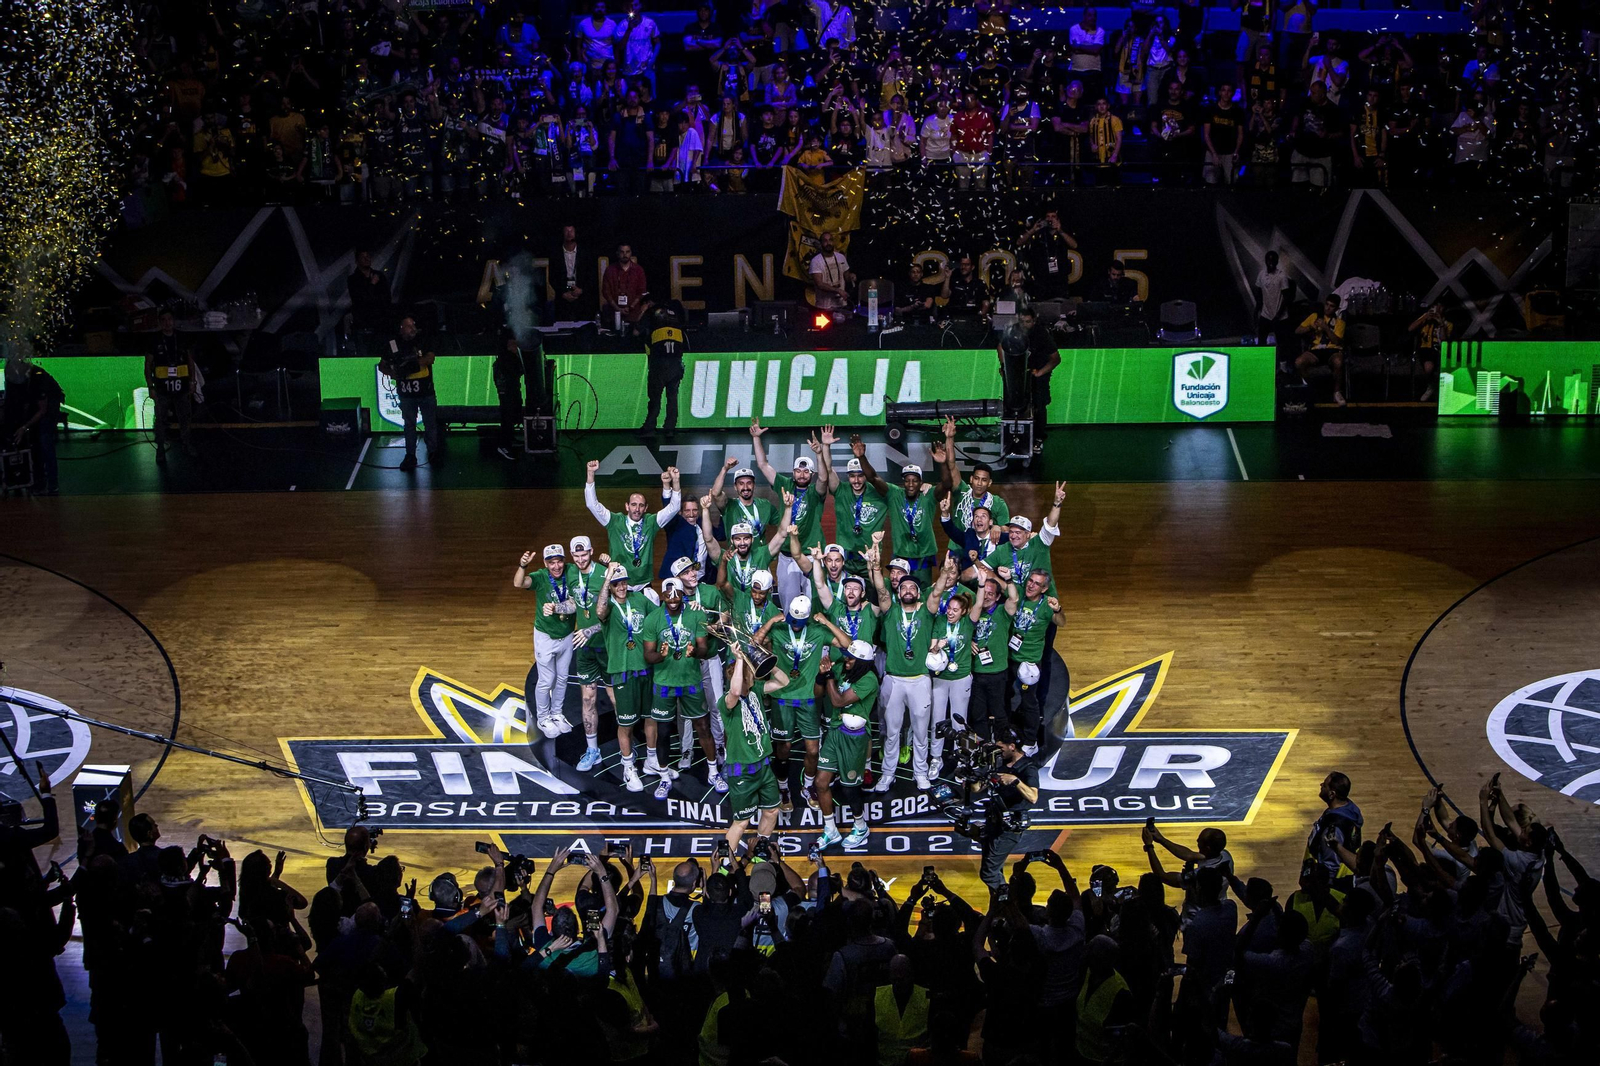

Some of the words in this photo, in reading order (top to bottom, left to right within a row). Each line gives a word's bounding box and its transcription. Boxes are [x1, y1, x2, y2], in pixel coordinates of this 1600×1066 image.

[165, 379, 182, 392] 116
[401, 380, 420, 393] 343
[690, 353, 921, 418] UNICAJA
[1181, 383, 1221, 391] Fundación
[1186, 392, 1216, 400] Unicaja
[667, 798, 728, 824] FINAL
[891, 794, 939, 818] 202
